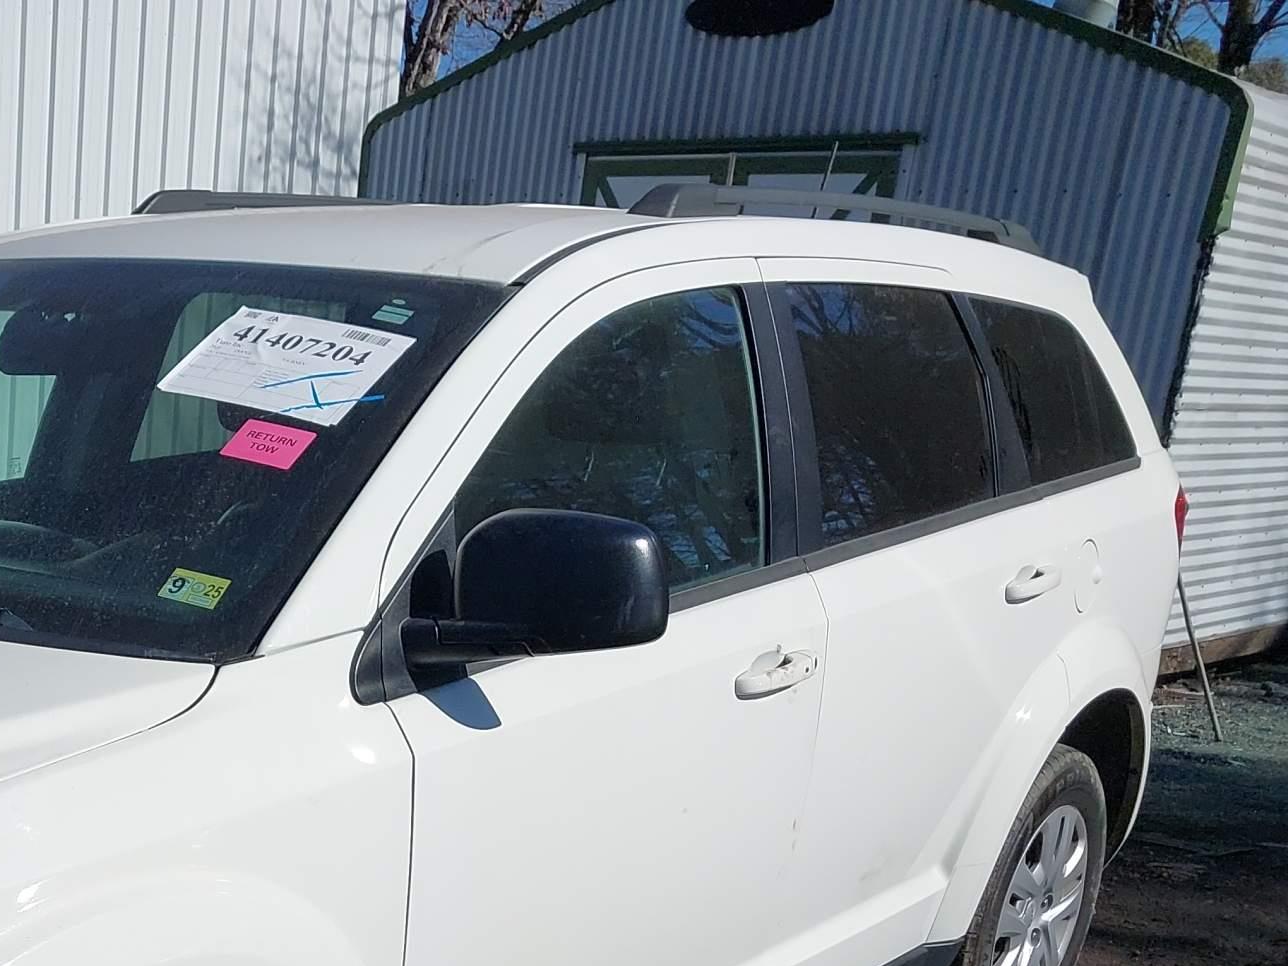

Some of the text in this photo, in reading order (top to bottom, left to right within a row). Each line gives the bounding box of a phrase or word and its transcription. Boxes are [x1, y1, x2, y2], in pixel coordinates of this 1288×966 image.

[232, 325, 372, 366] 41407204
[246, 430, 298, 447] RETURN
[249, 441, 280, 454] TOW
[167, 577, 225, 599] 9 25
